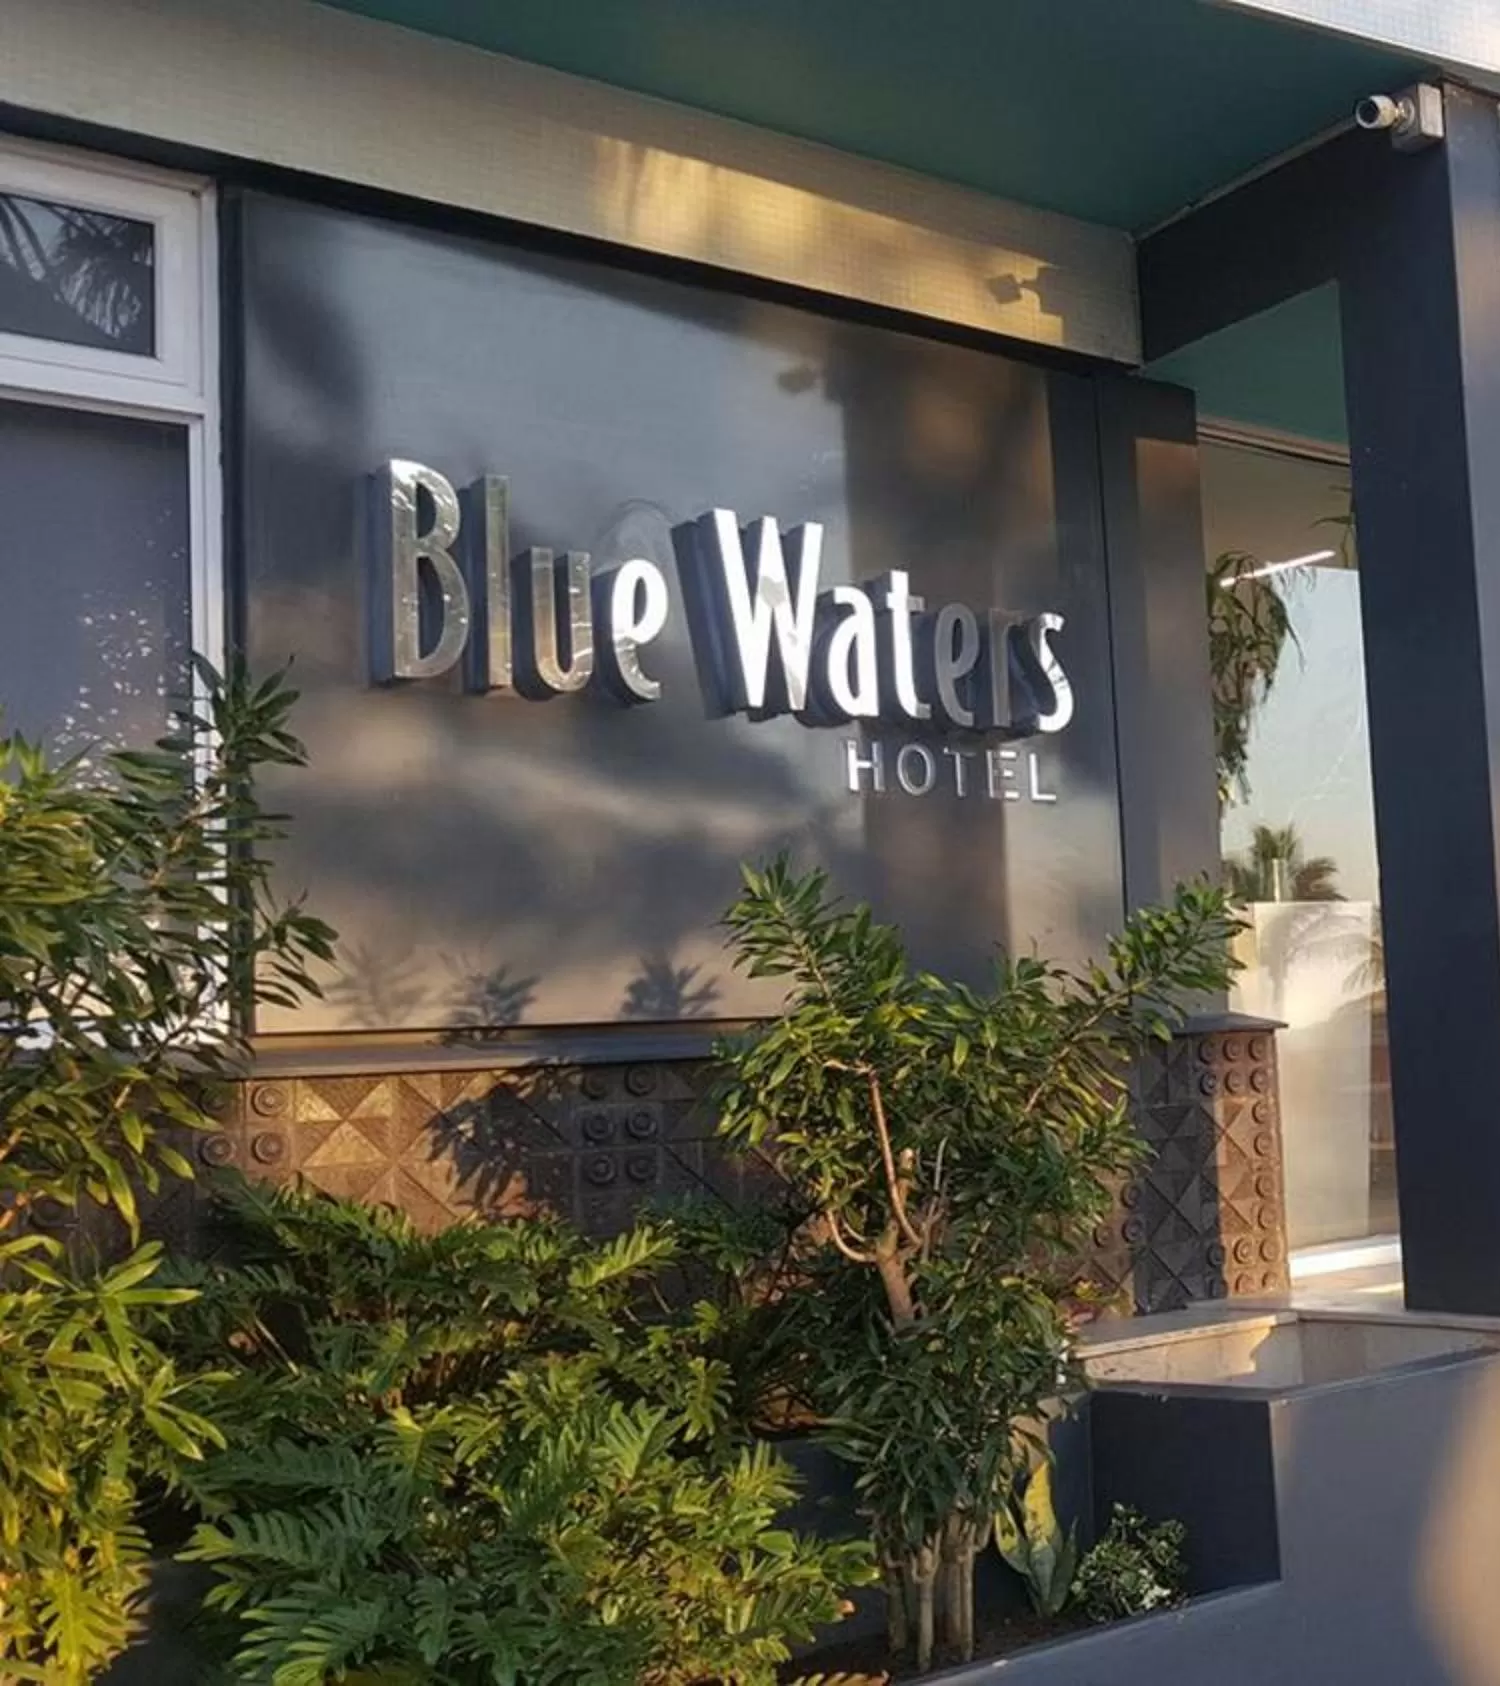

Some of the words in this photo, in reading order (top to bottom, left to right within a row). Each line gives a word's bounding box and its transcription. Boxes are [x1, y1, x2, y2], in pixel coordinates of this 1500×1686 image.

[386, 458, 669, 701] Blue
[710, 507, 1075, 733] Waters
[847, 738, 1057, 801] HOTEL
